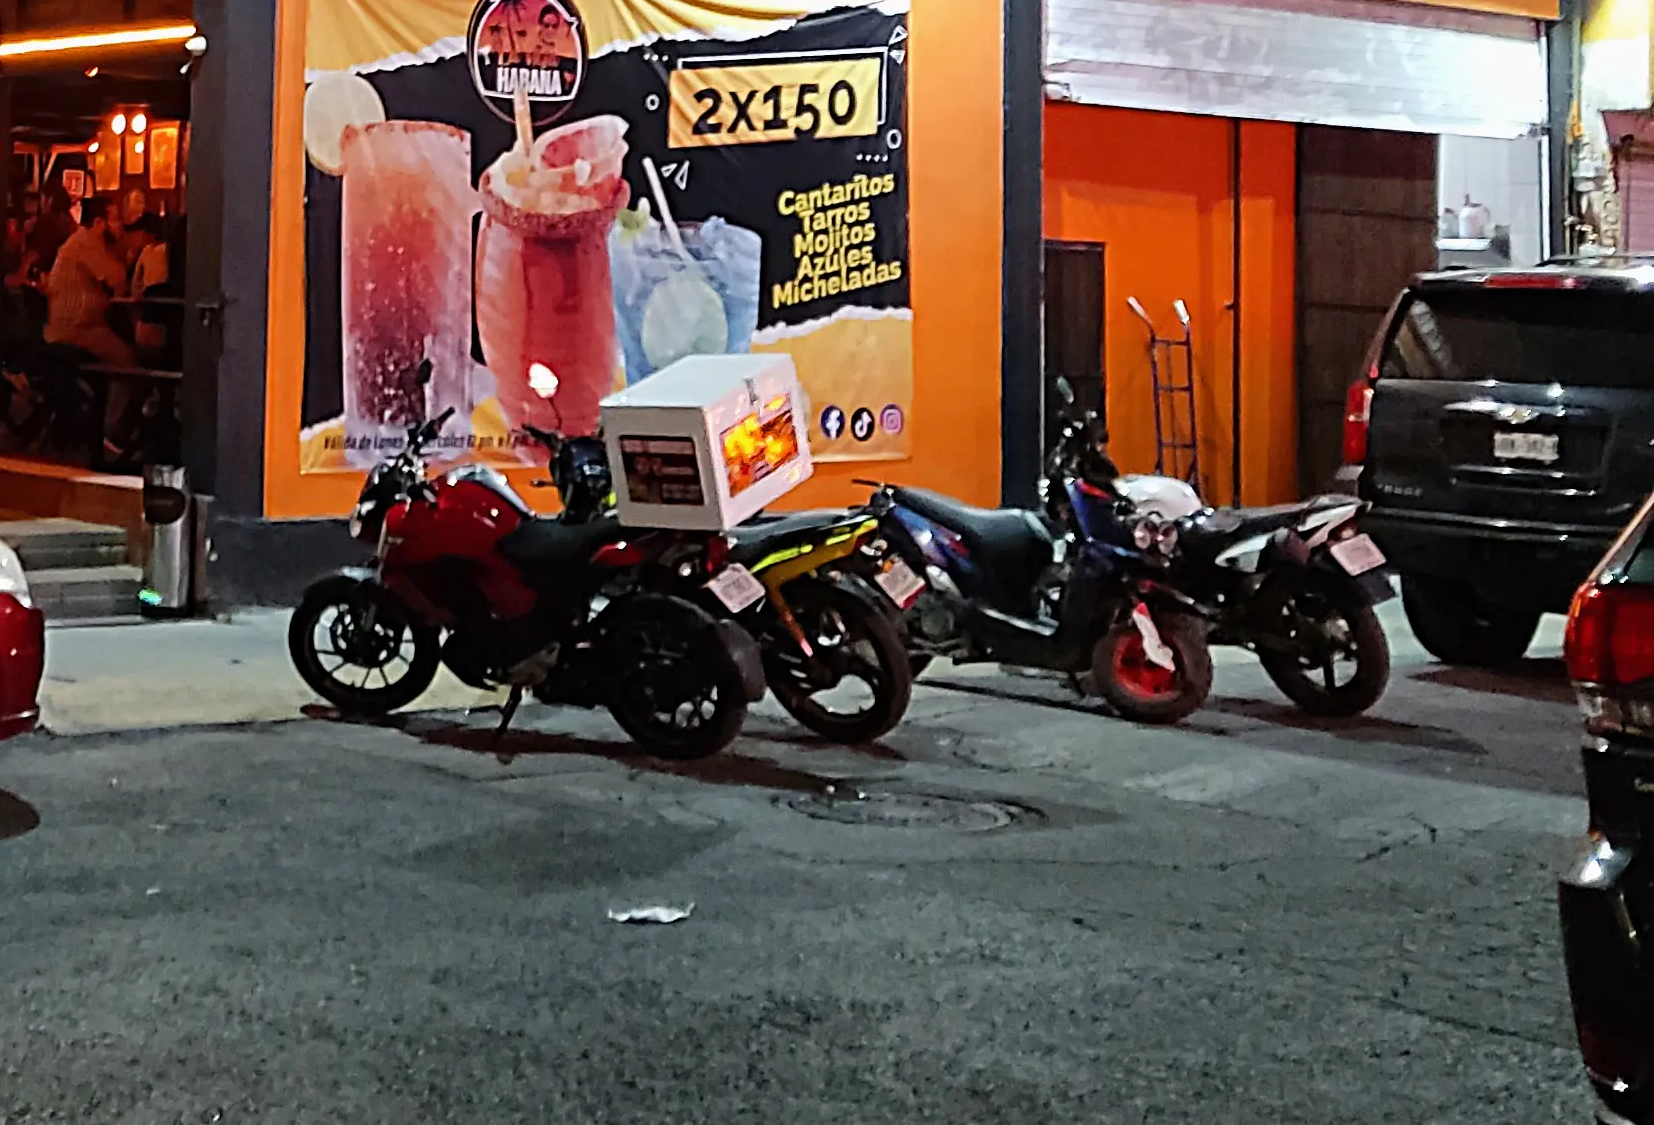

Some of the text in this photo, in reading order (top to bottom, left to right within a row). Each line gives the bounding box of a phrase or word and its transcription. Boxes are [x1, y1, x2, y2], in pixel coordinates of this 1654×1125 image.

[691, 80, 856, 139] 2X150
[778, 173, 895, 215] Cantaritos
[799, 201, 871, 233] Tarros
[793, 222, 876, 259] Mojitos
[796, 245, 873, 281] Azules
[772, 260, 902, 308] Micheladas
